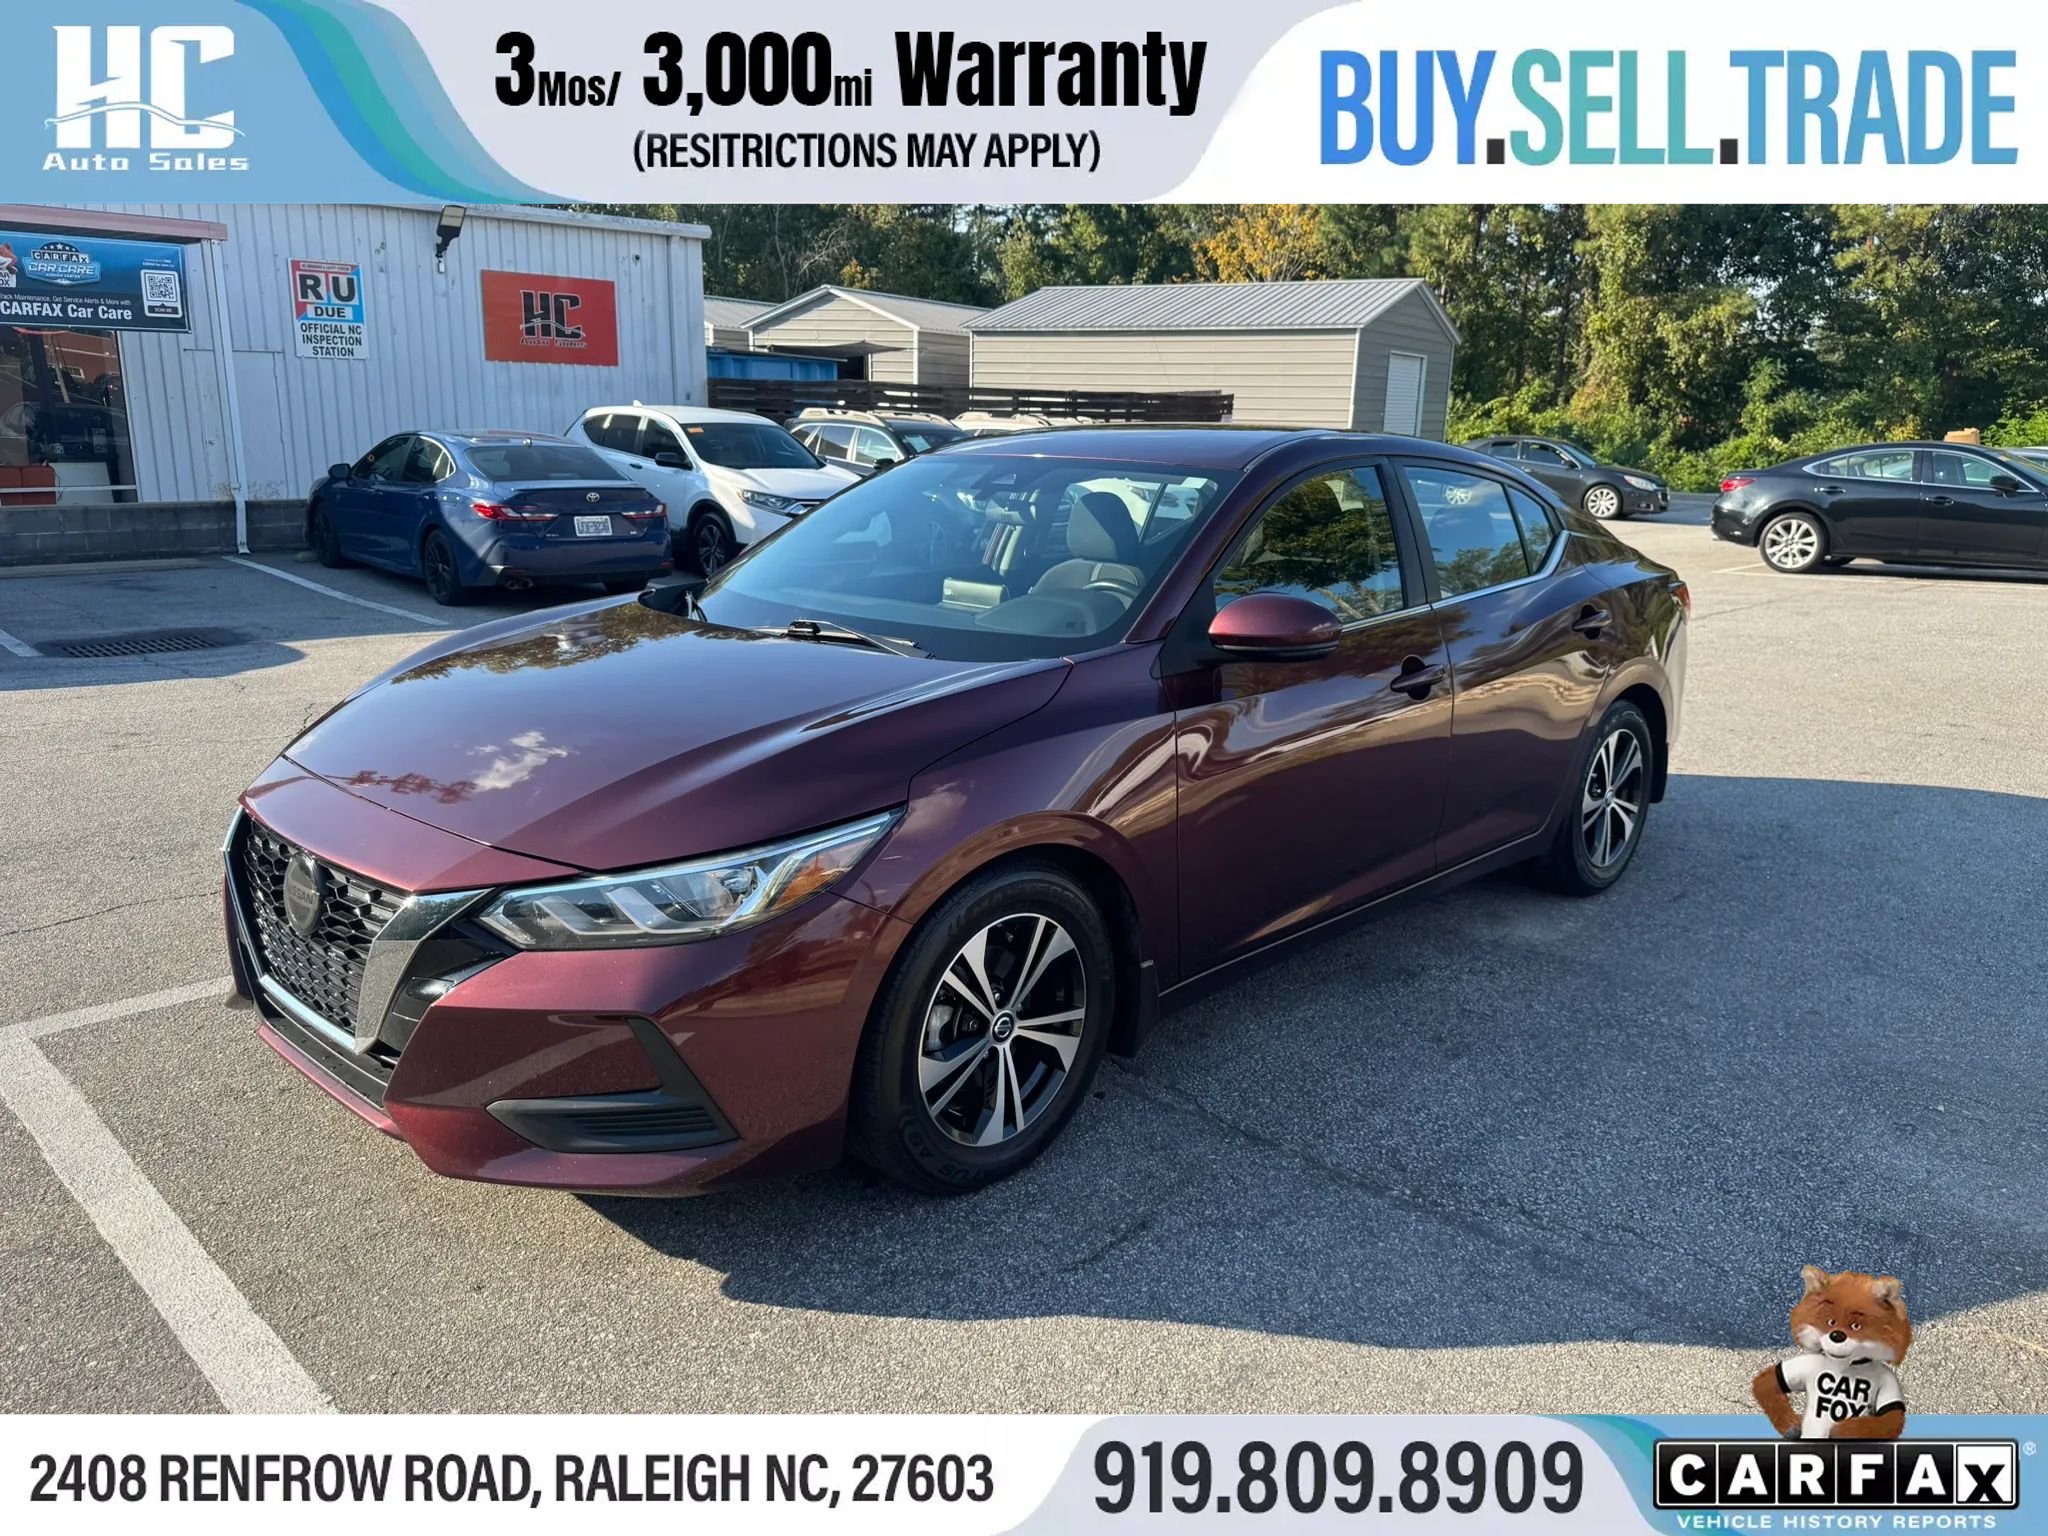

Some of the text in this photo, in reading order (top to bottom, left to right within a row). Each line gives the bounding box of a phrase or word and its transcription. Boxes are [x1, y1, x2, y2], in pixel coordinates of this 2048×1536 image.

[34, 252, 89, 264] CARFAX
[0, 271, 10, 279] AR
[28, 262, 95, 275] CAR CARE
[0, 279, 10, 287] OX
[298, 273, 356, 303] R U
[0, 300, 133, 320] CARFAX Car Care
[313, 305, 346, 319] DUE
[520, 289, 582, 341] HC
[300, 322, 362, 336] OFFICIAL NC
[302, 333, 362, 346] INSPECTION
[312, 345, 355, 357] STATION
